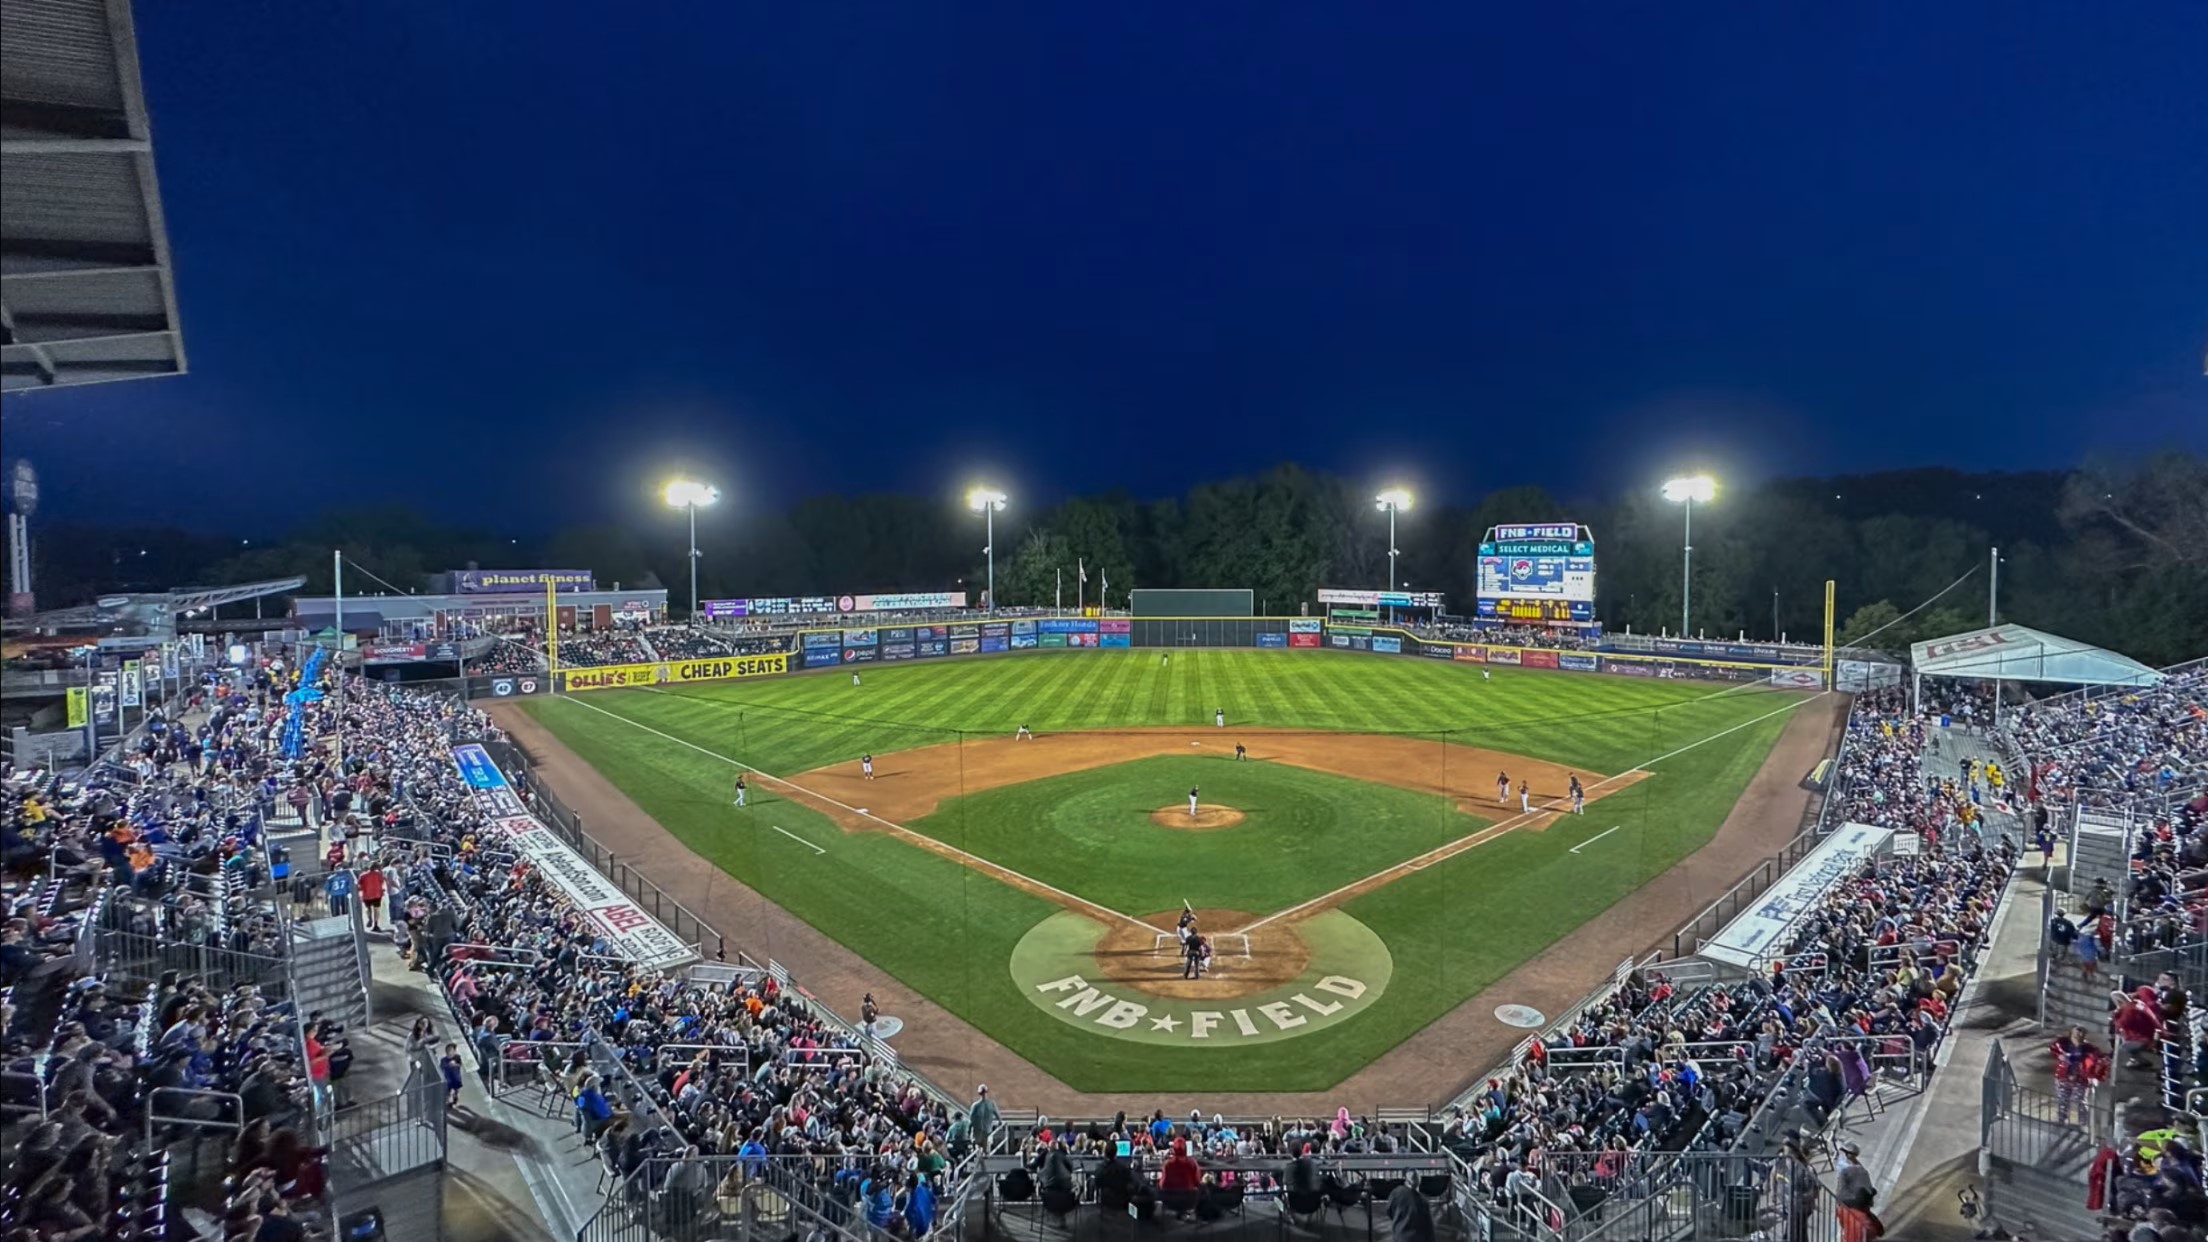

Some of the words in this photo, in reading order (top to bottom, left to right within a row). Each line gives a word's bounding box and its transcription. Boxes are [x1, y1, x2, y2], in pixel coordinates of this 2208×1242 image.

[1500, 528, 1526, 538] FNB
[1533, 527, 1573, 537] FIELD
[1499, 545, 1528, 553] SELECT
[482, 573, 536, 586] planet
[538, 573, 591, 583] fitness
[681, 661, 732, 679] CHEAP
[737, 658, 783, 675] SEATS
[571, 670, 626, 688] OLLIE'S
[596, 903, 650, 933] ABEL
[638, 926, 685, 959] ROOFING
[1036, 975, 1148, 1029] FNB
[1191, 975, 1367, 1038] FIELD
